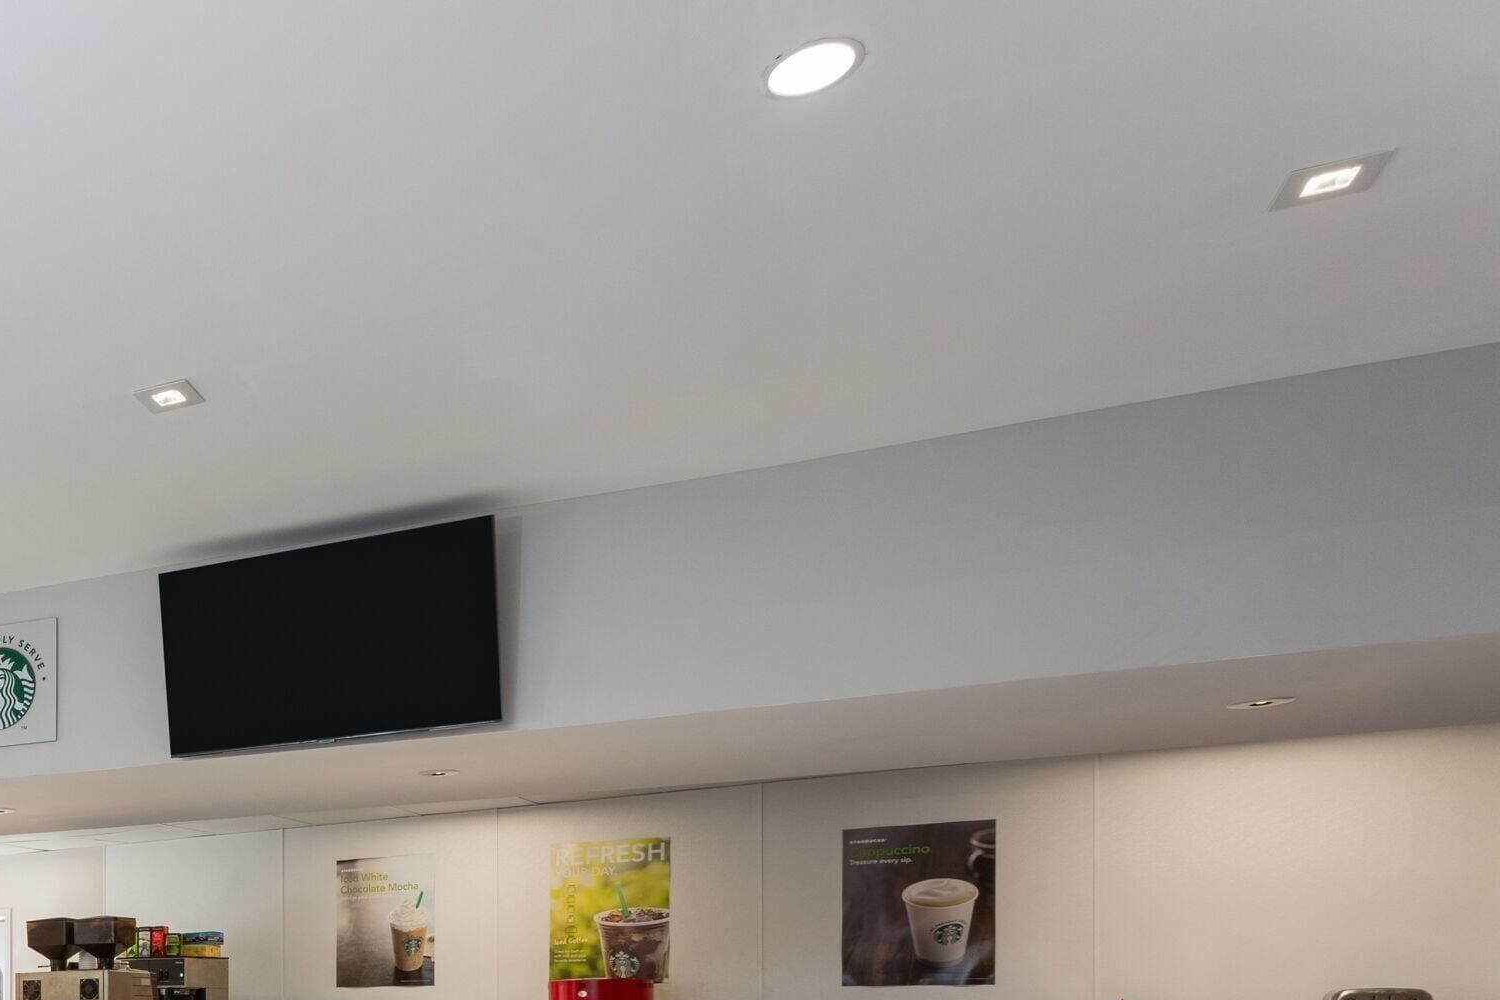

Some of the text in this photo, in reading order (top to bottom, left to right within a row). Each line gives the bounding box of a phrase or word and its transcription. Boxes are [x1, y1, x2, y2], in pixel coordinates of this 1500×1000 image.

[18, 639, 46, 670] SERVE
[556, 842, 665, 865] REFRESH
[849, 844, 931, 858] ppuccino
[879, 858, 899, 866] every
[900, 856, 913, 864] sip.
[591, 865, 616, 876] DAY
[341, 872, 388, 883] Iced White
[340, 882, 419, 895] Chocolate Mocha
